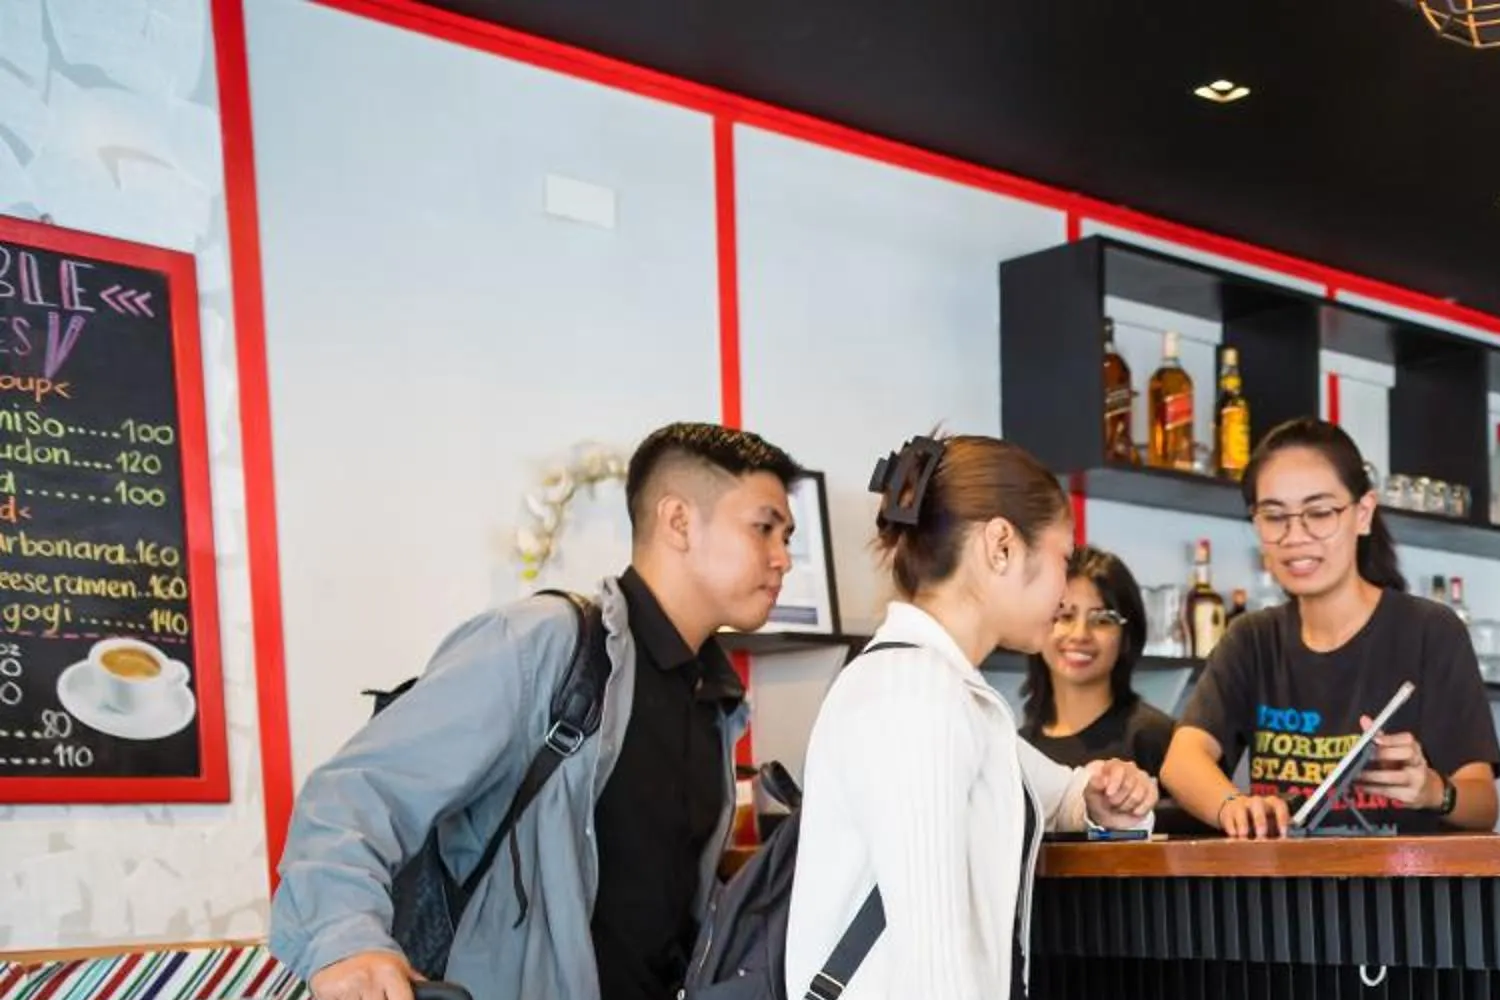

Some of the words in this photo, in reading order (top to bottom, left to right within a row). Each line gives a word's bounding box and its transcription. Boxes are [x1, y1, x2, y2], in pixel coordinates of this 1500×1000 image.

[121, 418, 174, 445] 100
[116, 451, 161, 475] 120
[115, 480, 165, 507] 100
[136, 538, 179, 567] 160
[53, 575, 136, 599] ramen
[150, 575, 188, 599] 160
[3, 600, 72, 635] gogi
[149, 608, 189, 636] 140
[41, 710, 72, 738] 80
[53, 743, 94, 767] 110
[1254, 731, 1361, 759] WORKIN
